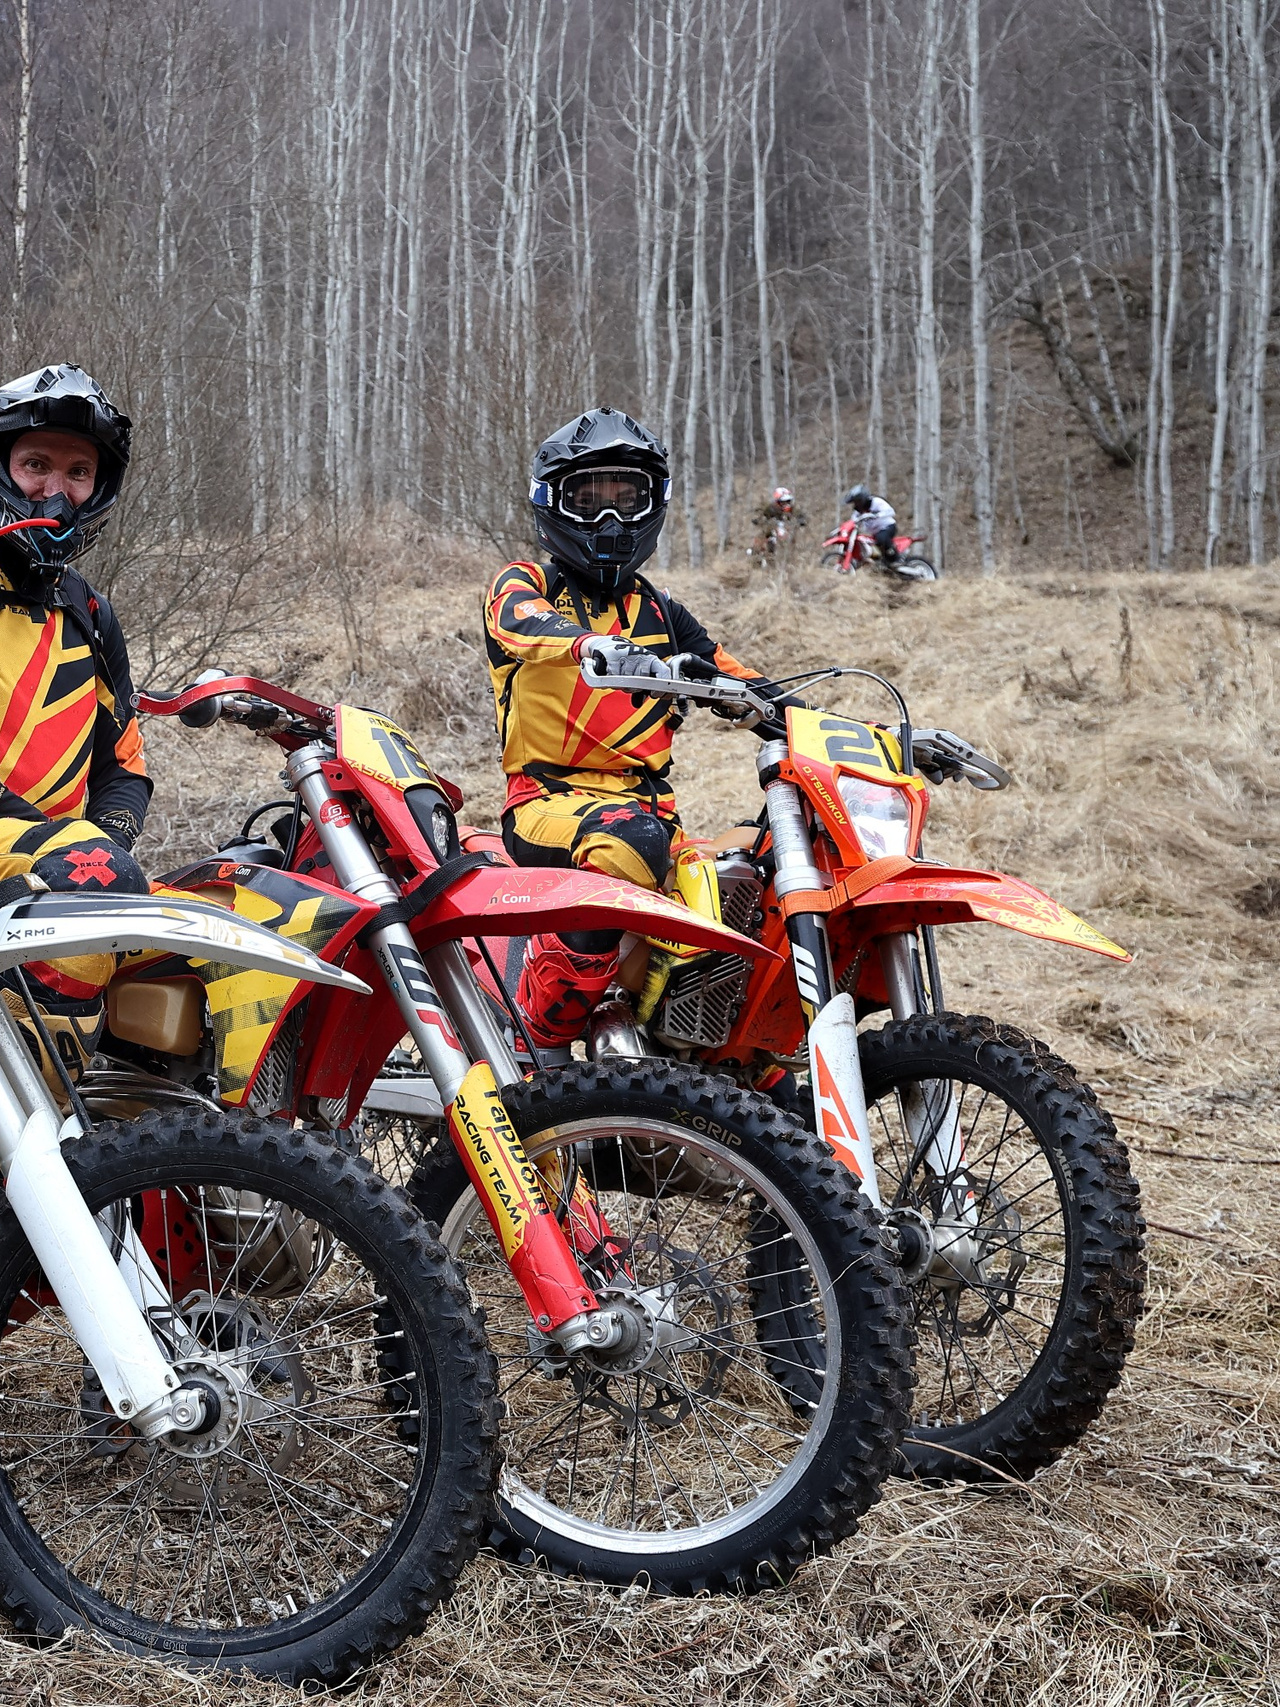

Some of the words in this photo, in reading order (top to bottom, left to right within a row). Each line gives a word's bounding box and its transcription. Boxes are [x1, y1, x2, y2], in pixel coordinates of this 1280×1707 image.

[501, 893, 531, 904] Com
[24, 927, 55, 938] RMG
[376, 947, 395, 981] XPLOR
[669, 1107, 743, 1148] X-GRIP
[455, 1094, 493, 1166] RACING
[489, 1167, 522, 1225] TEAM
